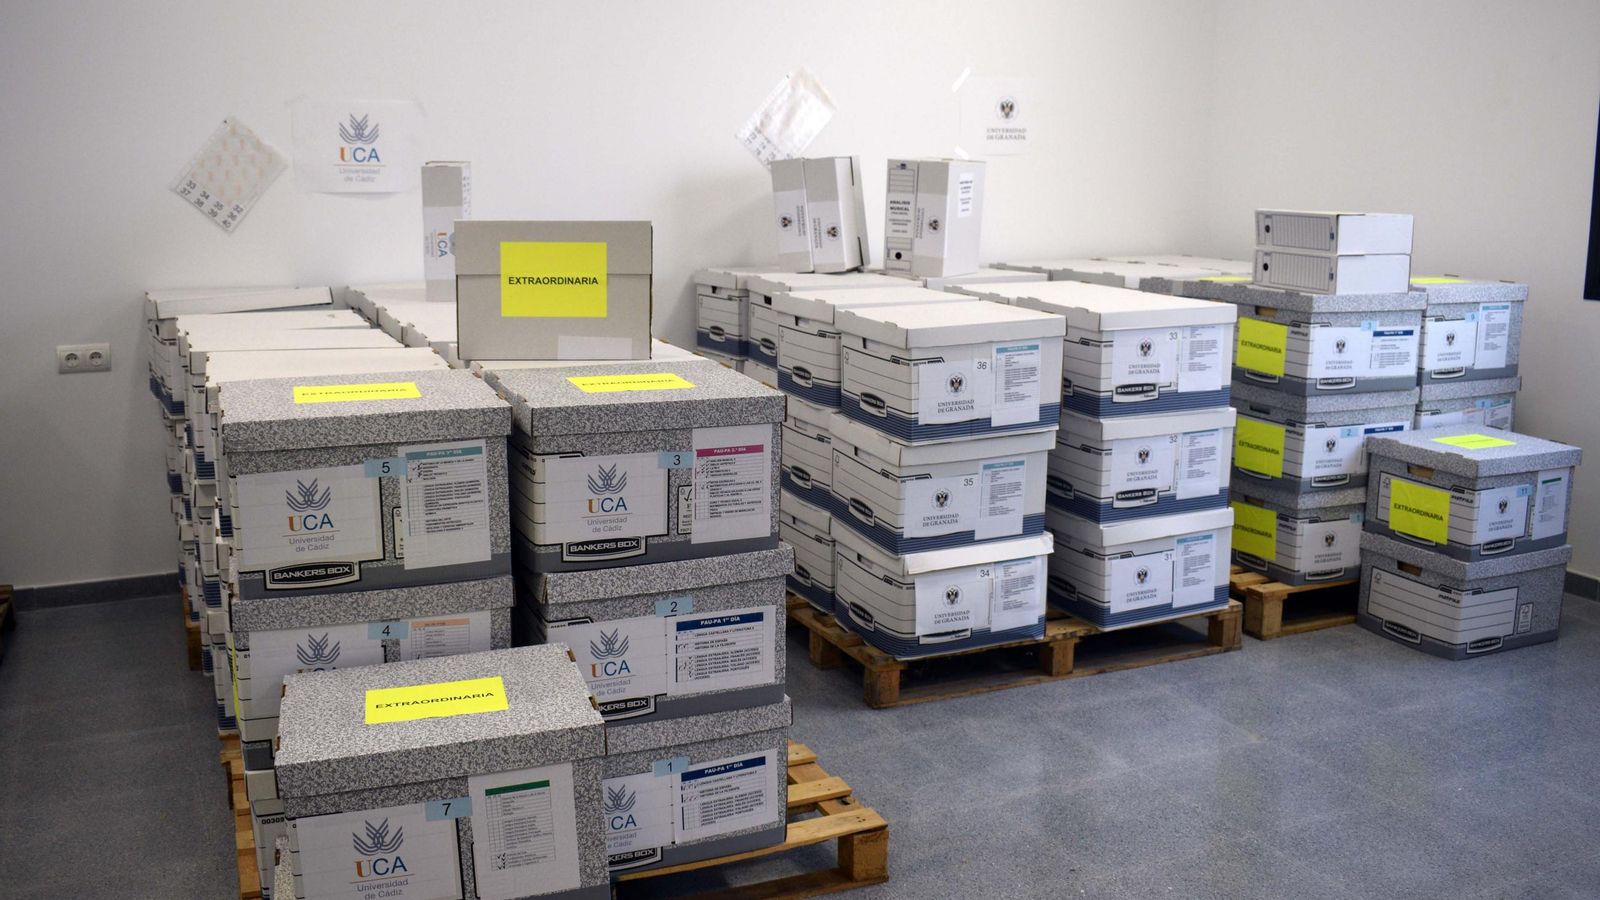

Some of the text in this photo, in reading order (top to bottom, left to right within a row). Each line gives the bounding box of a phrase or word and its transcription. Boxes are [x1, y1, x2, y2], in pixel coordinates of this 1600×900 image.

[339, 146, 380, 163] UCA
[180, 187, 191, 196] 37
[508, 276, 598, 285] EXTRAORDINARIA
[1169, 332, 1178, 340] 33
[1241, 340, 1282, 354] EXTRAORDINARIA
[977, 362, 987, 370] 36
[302, 388, 407, 396] EXTRAORDINARIA
[946, 405, 974, 413] GRANADA
[1169, 434, 1178, 444] 32
[1239, 440, 1280, 455] EXTRAORDINARIA
[673, 455, 681, 466] 3
[382, 462, 390, 474] 5
[964, 478, 974, 486] 35
[588, 497, 628, 514] UCA
[1393, 502, 1444, 522] EXTRAORDINARIA
[288, 513, 334, 532] UCA
[587, 517, 627, 526] Universidad
[923, 513, 959, 522] UNIVERSIDAD
[602, 524, 622, 532] Cádiz
[289, 534, 335, 545] Universidad
[296, 542, 329, 552] de Cádiz
[570, 540, 638, 552] BANKERS BOX
[274, 565, 351, 580] BANKERS BOX
[1126, 588, 1157, 597] UNIVERSIDAD
[1133, 594, 1157, 602] GRANADA
[671, 602, 678, 612] 2
[934, 610, 970, 619] UNIVERSIDAD
[942, 615, 970, 624] GRANADA
[382, 625, 390, 636] 4
[591, 660, 631, 678] UCA
[591, 679, 631, 690] Universidad
[607, 687, 626, 695] Cádiz
[375, 692, 494, 709] EXTRAORDINARIA
[626, 700, 647, 708] BOX
[668, 762, 672, 773] 1
[442, 803, 451, 816] 7
[608, 814, 637, 830] CA
[614, 840, 632, 848] Cádiz
[635, 849, 654, 857] BOX
[354, 856, 407, 878] UCA
[357, 879, 409, 892] Universidad
[364, 889, 402, 900] de Cádiz
